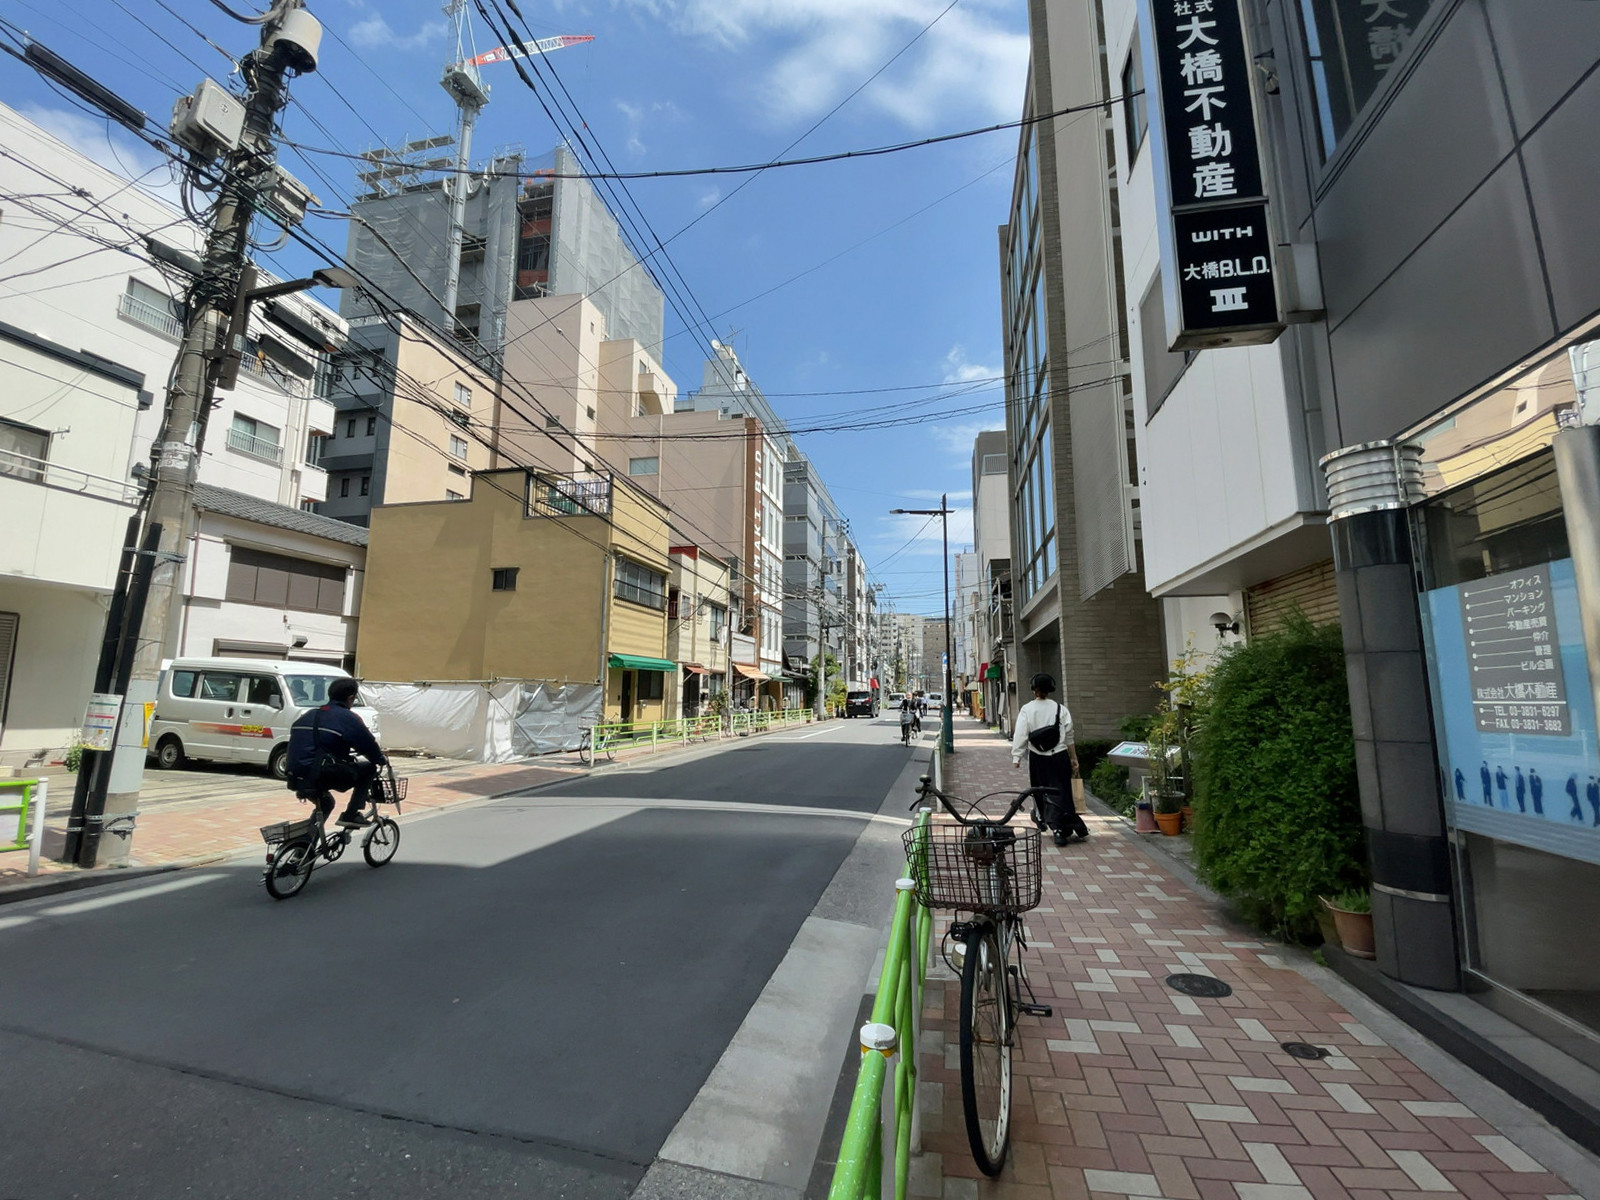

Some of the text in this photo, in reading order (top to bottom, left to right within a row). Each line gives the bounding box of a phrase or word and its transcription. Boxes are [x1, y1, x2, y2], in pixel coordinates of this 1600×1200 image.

[1176, 16, 1237, 198] 大橋不動産
[1191, 226, 1253, 243] WITH
[1509, 575, 1542, 589] オフィス
[1503, 589, 1543, 604] マンション
[1506, 602, 1546, 617] パーキング
